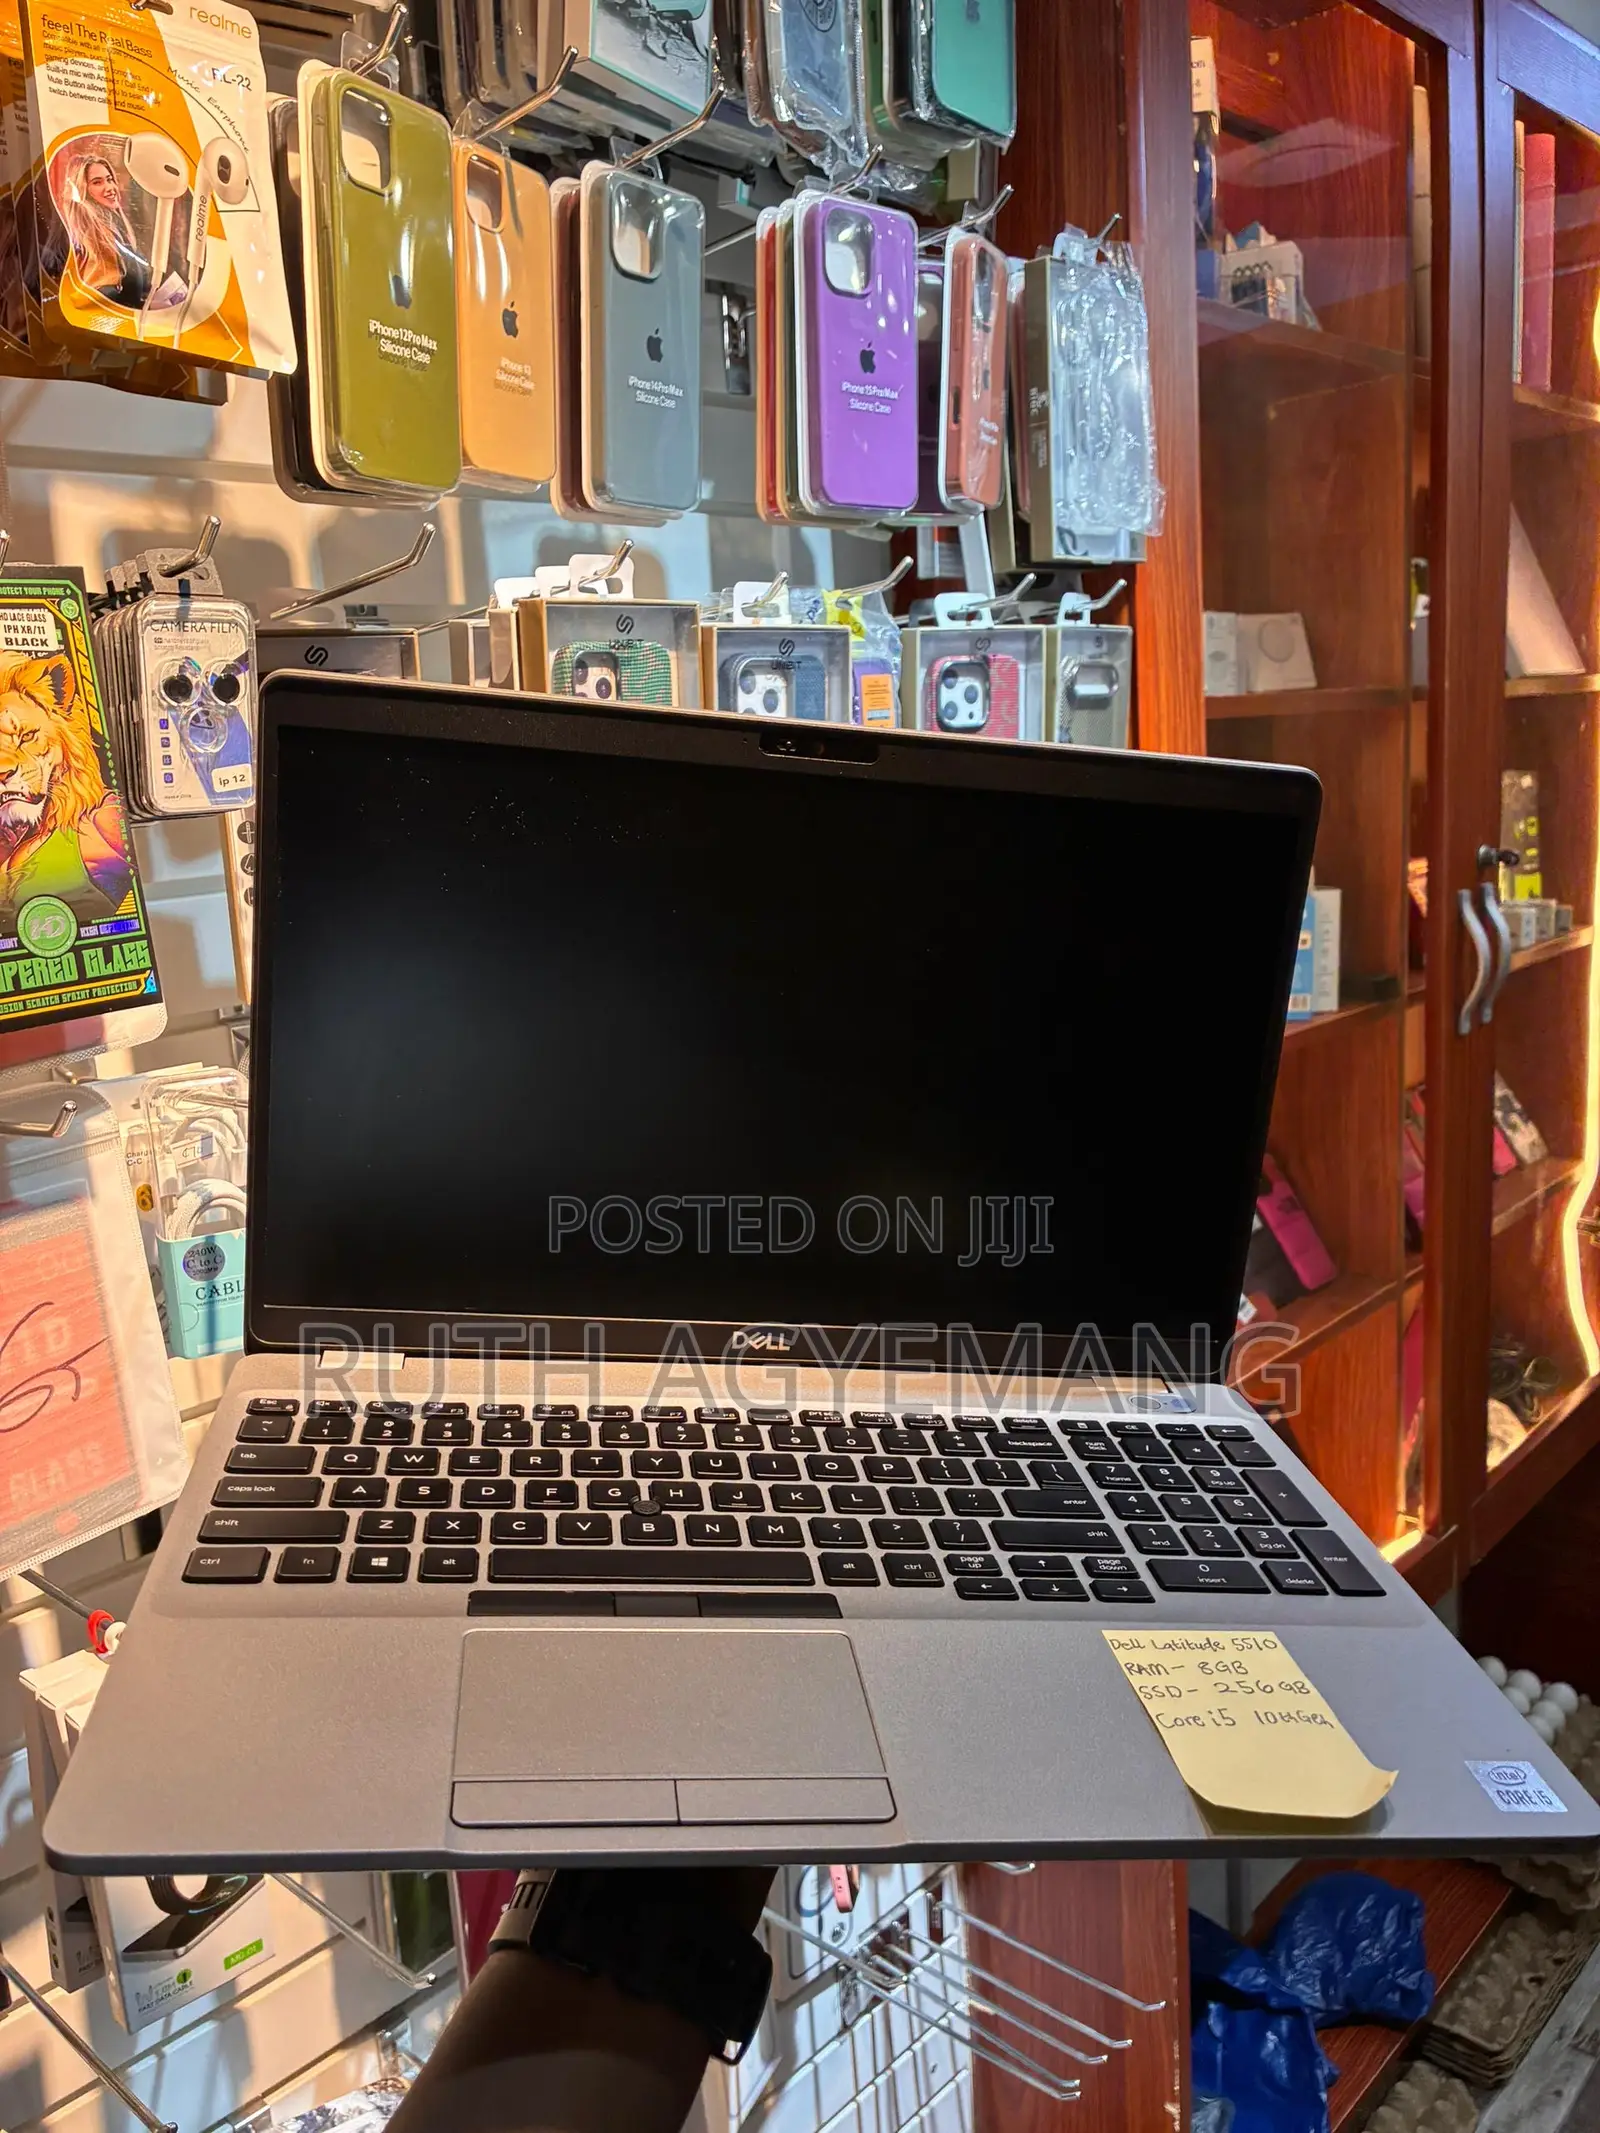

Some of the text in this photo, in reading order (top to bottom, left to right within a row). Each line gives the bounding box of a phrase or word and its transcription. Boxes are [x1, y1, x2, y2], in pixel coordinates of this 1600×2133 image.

[190, 6, 252, 39] realme
[41, 14, 73, 36] feeel
[76, 23, 98, 41] The
[100, 31, 124, 50] Real
[126, 40, 153, 58] Bass
[64, 79, 86, 90] Button
[167, 66, 201, 94] Music
[69, 90, 97, 102] between
[207, 96, 250, 153] Earphone
[196, 195, 208, 242] realme
[369, 319, 399, 339] iPhone
[421, 334, 438, 351] Max
[380, 338, 431, 364] Silicone Case
[628, 375, 651, 391] iPhone
[669, 384, 684, 397] Max
[841, 380, 865, 395] iPhone
[636, 389, 676, 409] Silicone Case
[874, 401, 892, 414] Case
[23, 587, 42, 596] YOUR
[43, 587, 65, 596] PHONE
[9, 612, 25, 621] LACE
[26, 613, 47, 622] GLASS
[4, 625, 46, 635] IPH XR/11
[150, 619, 239, 634] CAMERA FILM
[5, 637, 49, 647] BLACK
[218, 774, 246, 787] ip 12
[80, 926, 99, 938] HIGH
[82, 940, 152, 979] GLASS
[26, 993, 60, 1009] SCRATCH
[92, 981, 138, 998] PROTECTION
[187, 1246, 217, 1259] 240W
[195, 1279, 245, 1301] CABL
[732, 1330, 792, 1351] DELL
[344, 1454, 358, 1462] Q
[419, 1486, 430, 1494] S
[482, 1487, 495, 1495] D
[547, 1488, 557, 1496] F
[608, 1488, 621, 1496] G
[670, 1489, 683, 1497] H
[379, 1520, 393, 1528] Z
[447, 1521, 460, 1529] X
[513, 1522, 525, 1530] C
[577, 1522, 591, 1530] V
[643, 1523, 655, 1531] B
[706, 1524, 719, 1532] N
[768, 1525, 784, 1533] M
[960, 1557, 984, 1565] page
[966, 1561, 981, 1570] up
[1097, 1560, 1122, 1568] page
[1109, 1637, 1278, 1652] Dell Latitude 5510
[1198, 1660, 1249, 1677] 8GB
[1213, 1680, 1274, 1695] 256
[1155, 1712, 1205, 1729] Core
[1208, 1708, 1237, 1728] i5
[1491, 1768, 1524, 1783] intel
[1496, 1789, 1538, 1805] CORE
